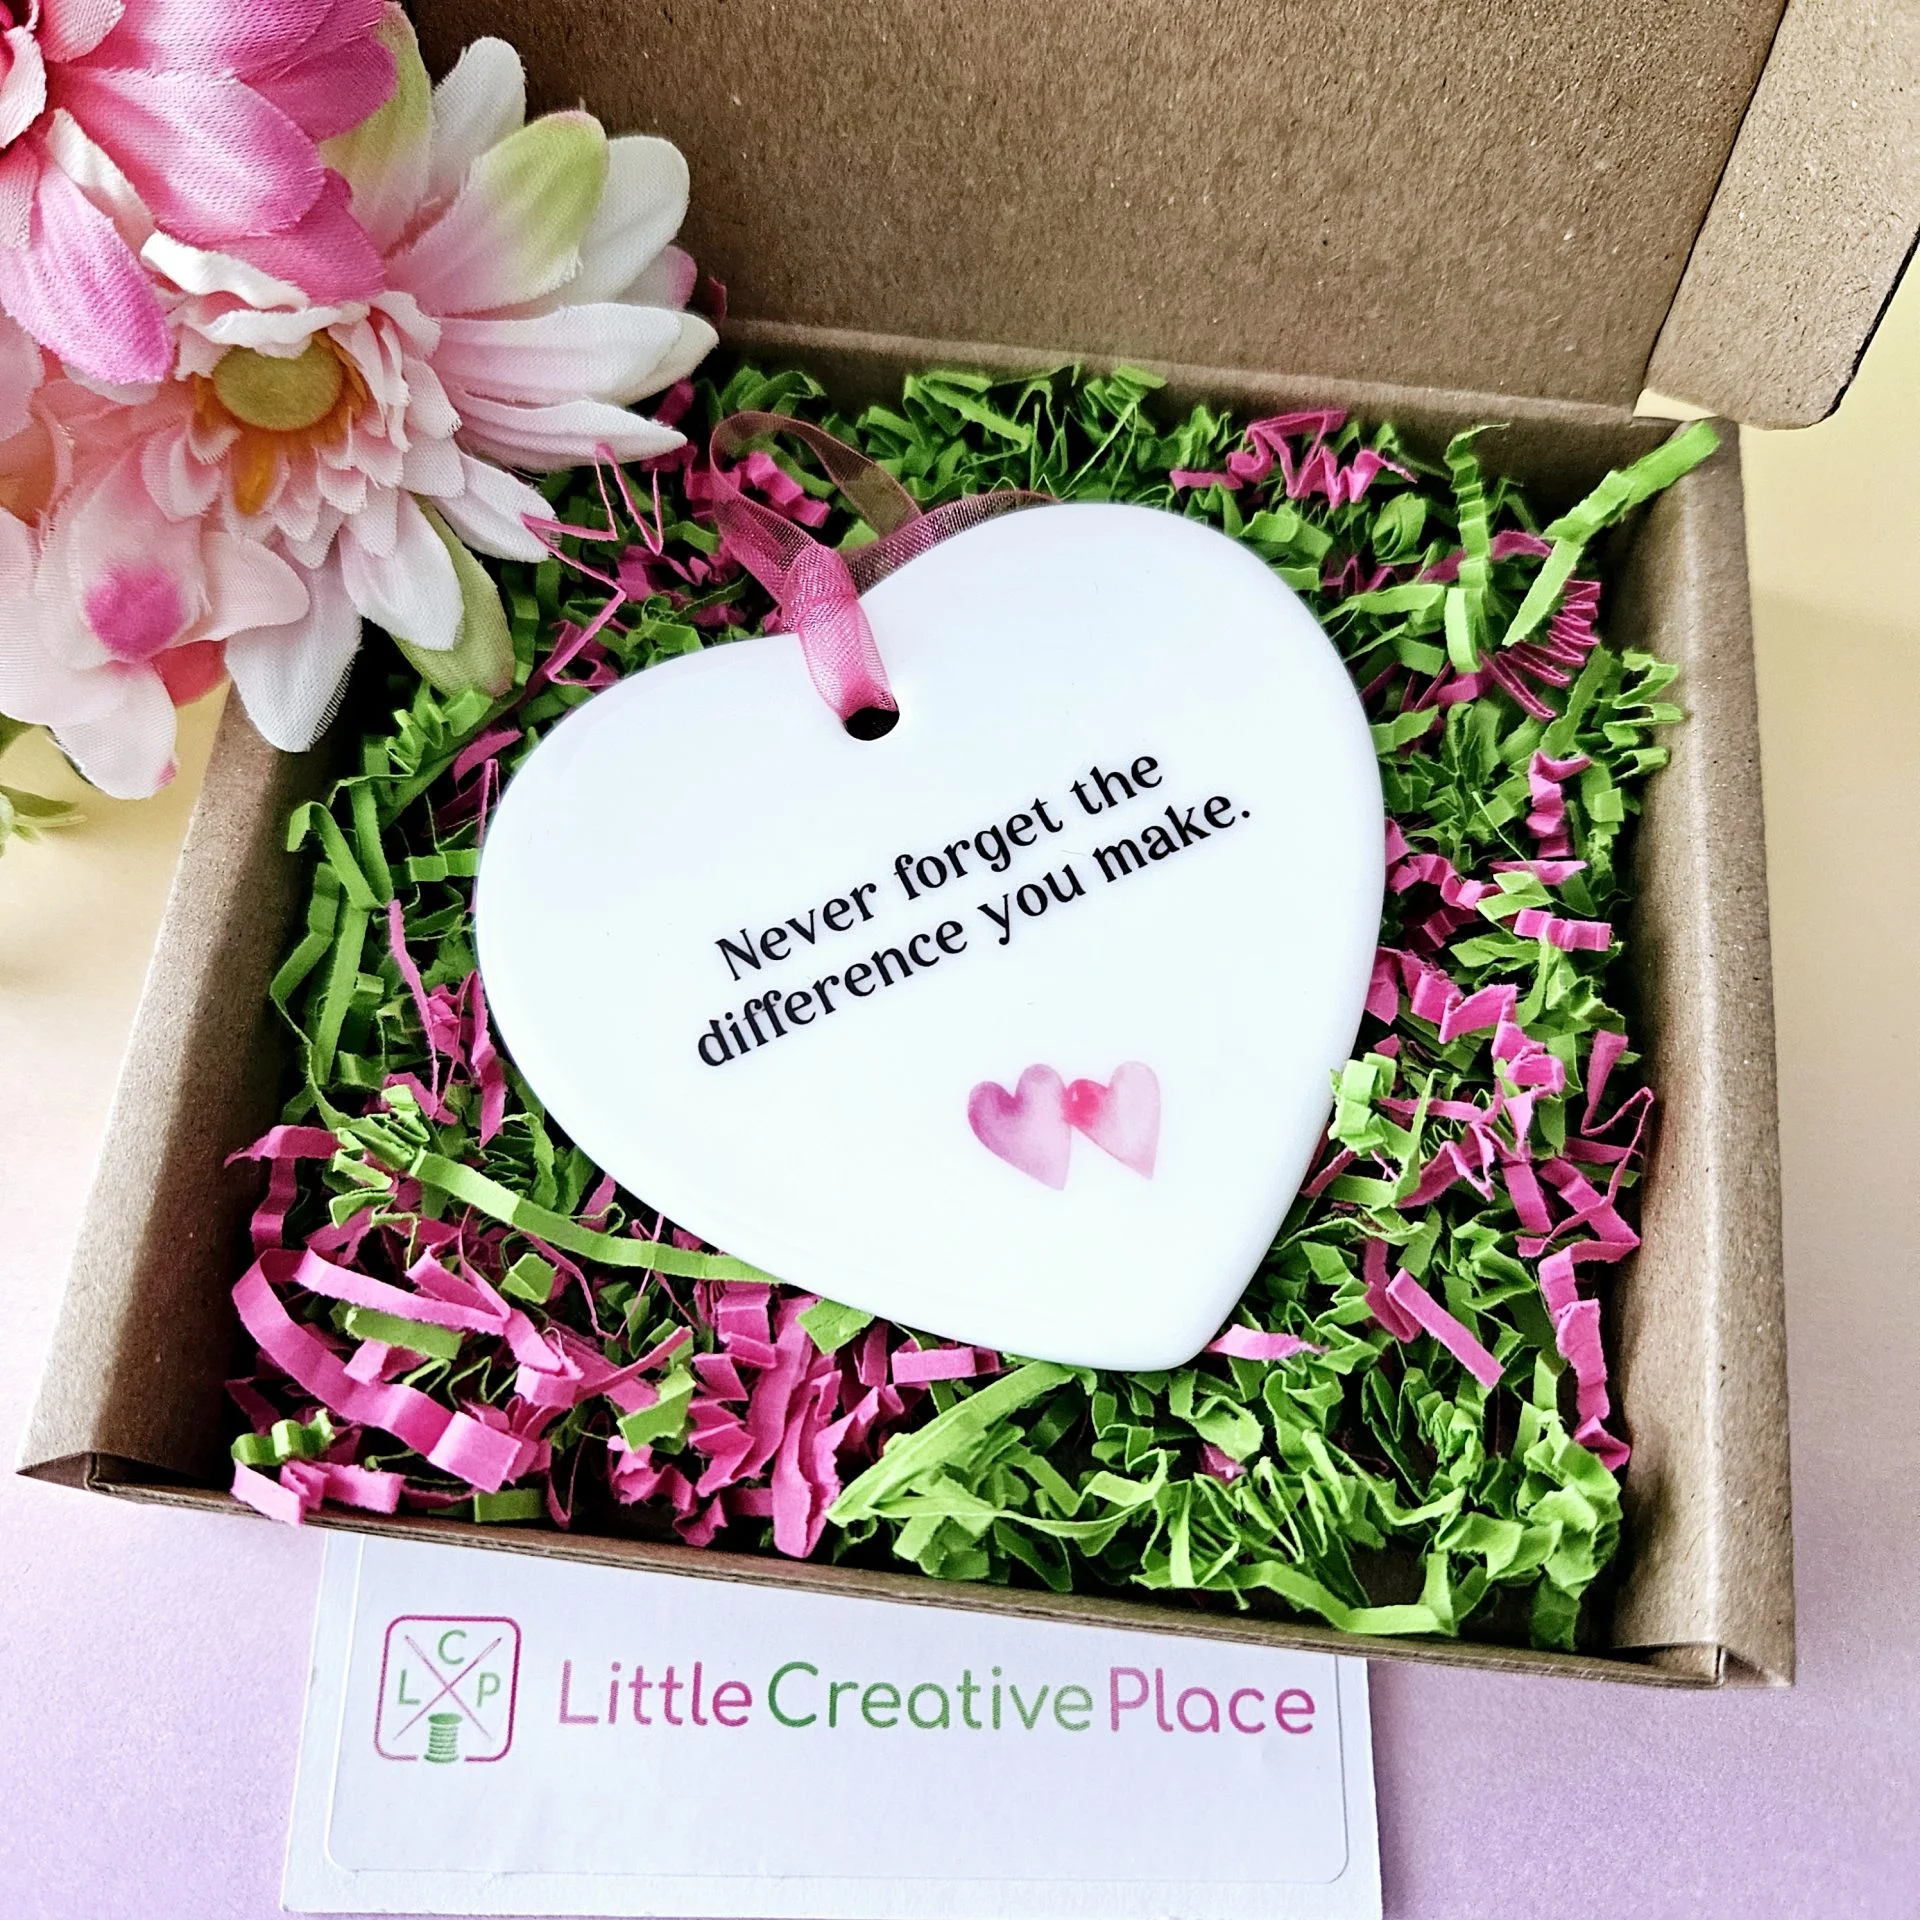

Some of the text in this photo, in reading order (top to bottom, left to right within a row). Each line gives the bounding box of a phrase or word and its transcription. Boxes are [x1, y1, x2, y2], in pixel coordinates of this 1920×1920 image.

[697, 795, 1251, 1067] difference you make.
[714, 755, 1163, 982] Never forget the
[437, 1629, 467, 1665] C
